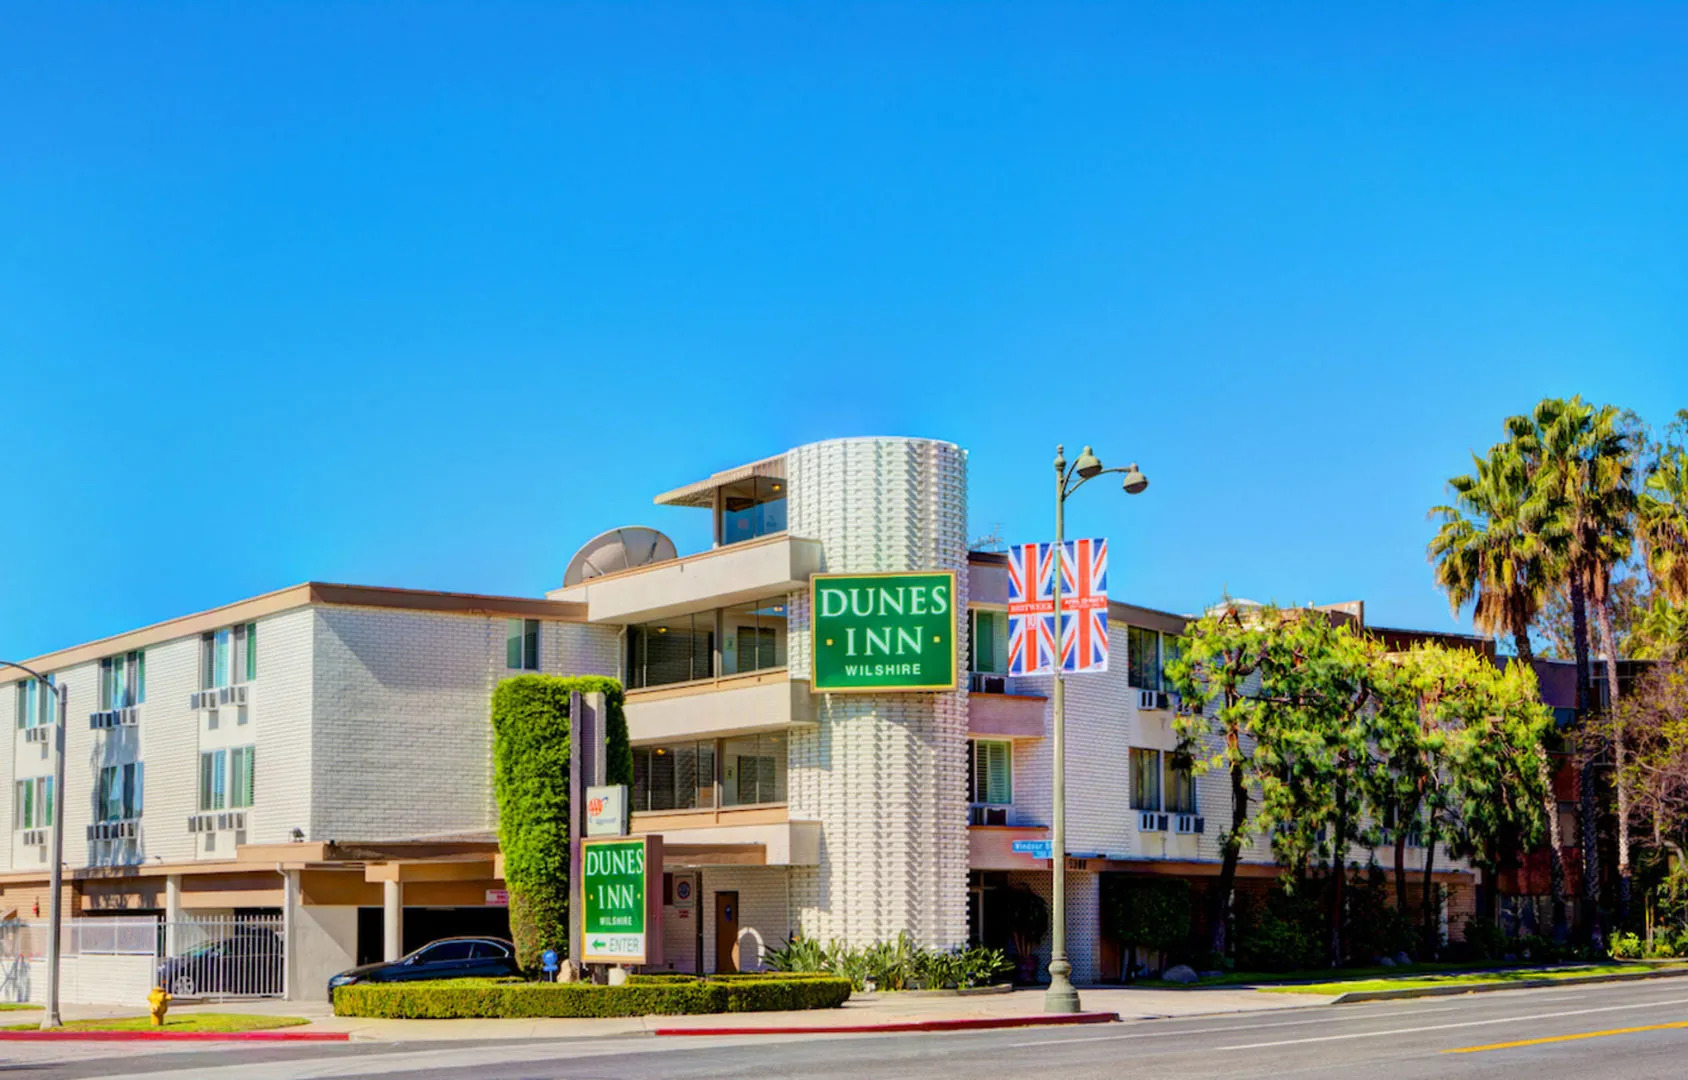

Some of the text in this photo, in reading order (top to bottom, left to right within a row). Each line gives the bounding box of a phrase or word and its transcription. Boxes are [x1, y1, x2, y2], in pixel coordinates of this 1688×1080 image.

[820, 585, 948, 617] DUNES
[845, 626, 924, 656] INN
[845, 663, 921, 676] WILSHIRE
[587, 848, 644, 876] DUNES
[598, 884, 634, 909] INN
[600, 916, 633, 926] WILSHIRE
[609, 937, 639, 953] ENTER
